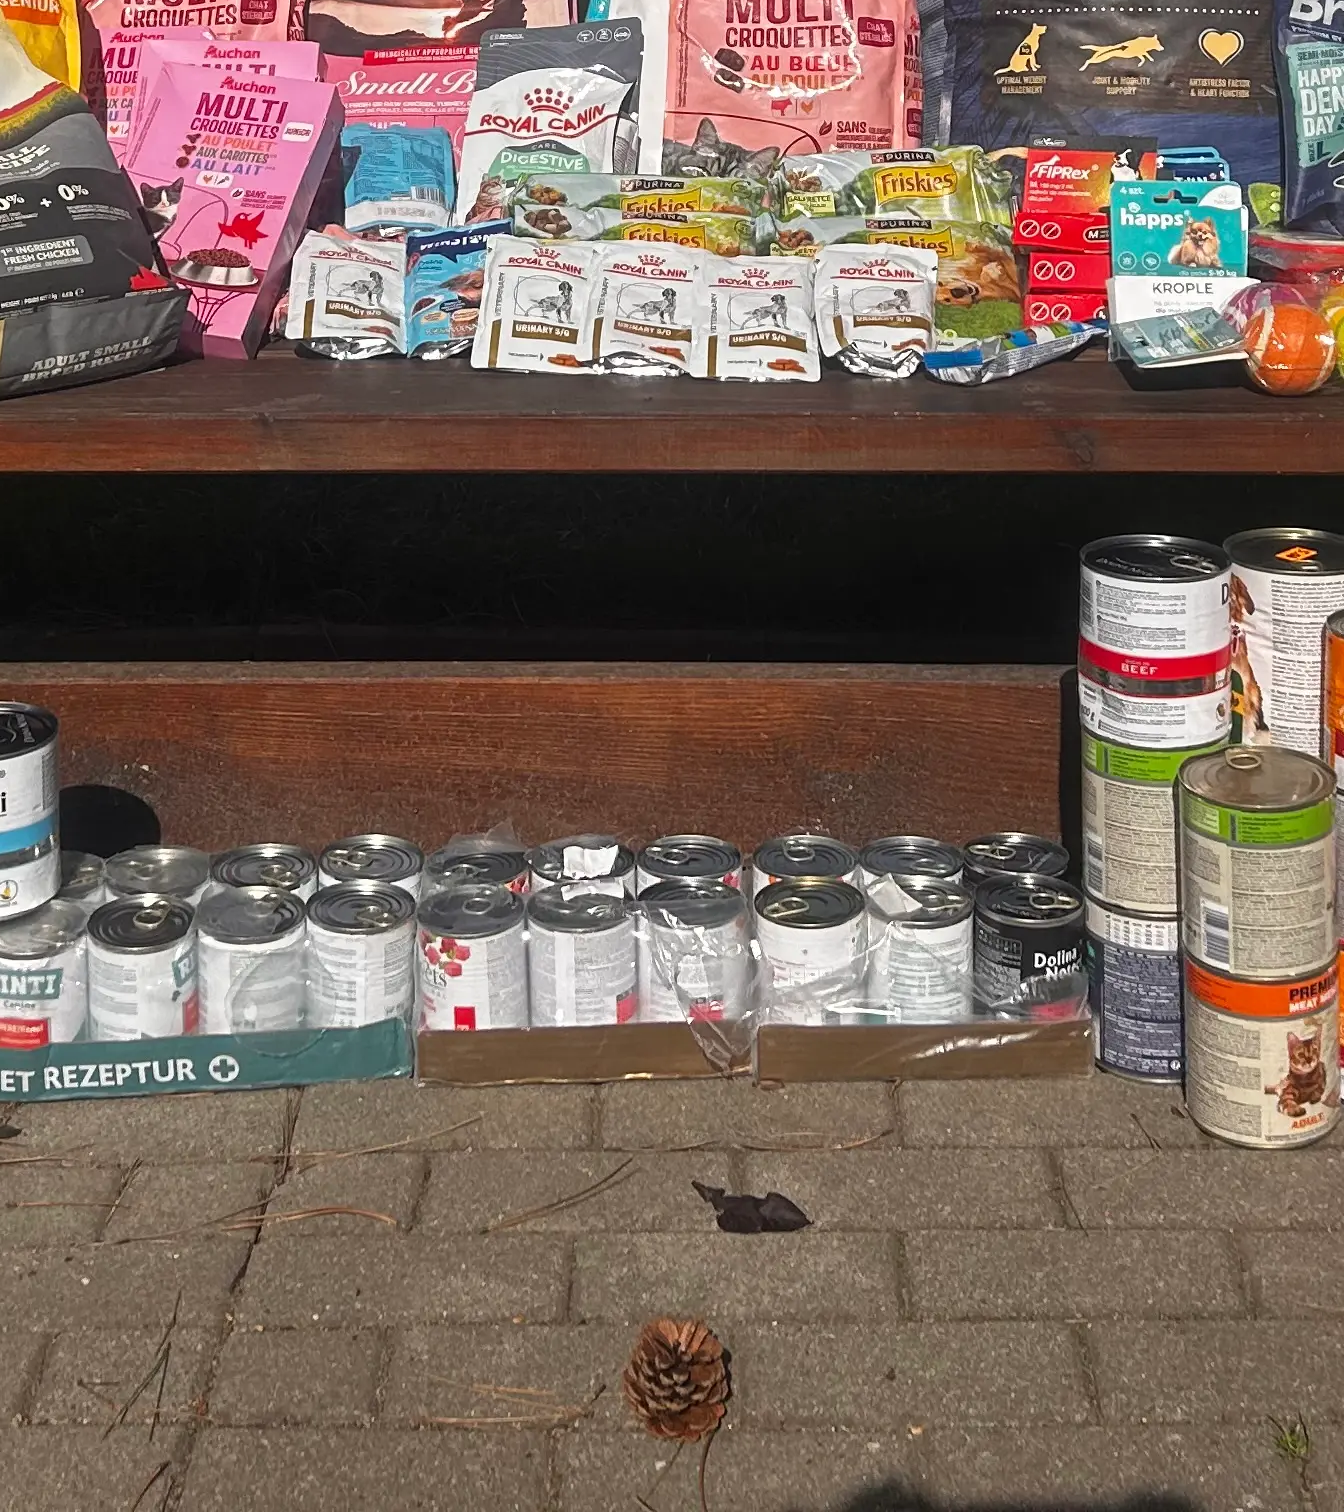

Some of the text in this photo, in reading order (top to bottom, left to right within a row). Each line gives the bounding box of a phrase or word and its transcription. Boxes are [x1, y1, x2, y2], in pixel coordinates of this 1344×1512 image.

[120, 4, 237, 28] CROQUETTES
[726, 26, 852, 48] CROQUETTES
[204, 46, 260, 60] Auchan
[220, 76, 276, 94] Auchan
[336, 71, 438, 97] Small
[196, 92, 288, 124] MULTI
[480, 104, 605, 132] ROYAL CANIN
[836, 122, 867, 133] SANS
[1303, 115, 1335, 137] DAY
[190, 117, 279, 139] CROQUETTES
[501, 152, 585, 170] DIGESTIVE
[886, 152, 934, 162] PURINA
[881, 173, 953, 196] Friskies
[880, 220, 929, 228] PURINA
[1121, 208, 1184, 229] happs
[4, 254, 35, 265] FRESH
[36, 248, 79, 262] CHICKEN
[509, 256, 583, 275] ROYAL CANIN
[613, 263, 687, 278] ROYAL CANIN
[840, 268, 914, 278] ROYAL CANIN
[1153, 283, 1214, 294] KROPLE
[32, 336, 152, 371] ADULT SMALL
[1121, 664, 1158, 675] BEEF
[1034, 949, 1077, 968] Dolina
[44, 1058, 195, 1090] REZEPTUR
